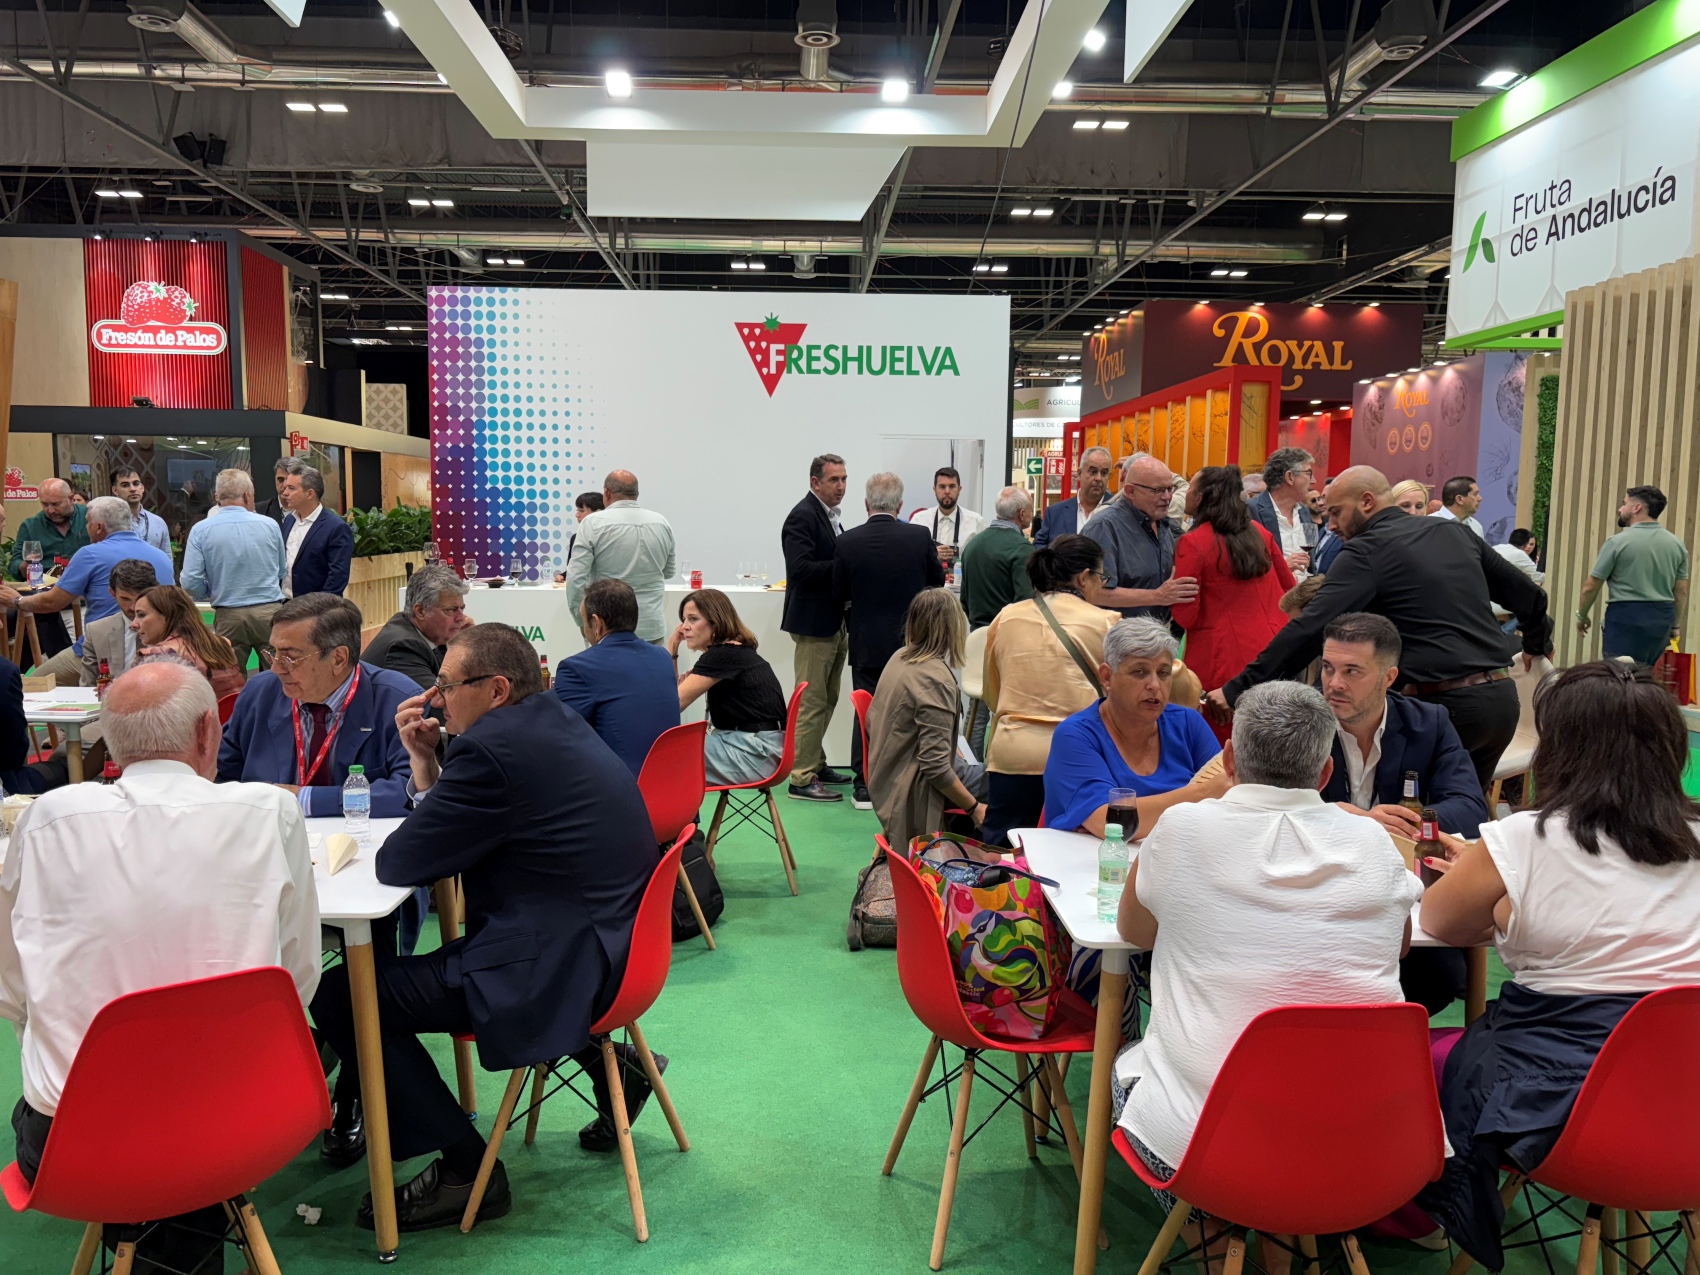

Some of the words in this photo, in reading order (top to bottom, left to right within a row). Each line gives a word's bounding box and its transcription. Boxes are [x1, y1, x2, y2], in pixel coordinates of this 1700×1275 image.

[1510, 224, 1538, 257] de
[1545, 166, 1677, 246] Andalucía
[1512, 178, 1572, 225] Fruta
[100, 328, 155, 346] Fresón
[156, 329, 175, 346] de
[175, 330, 218, 347] Palos
[1212, 311, 1353, 391] ROYAL
[769, 343, 961, 377] FRESHUELVA
[1094, 333, 1126, 400] ROYAL
[1393, 378, 1430, 418] ROYAL
[16, 489, 37, 497] Palos
